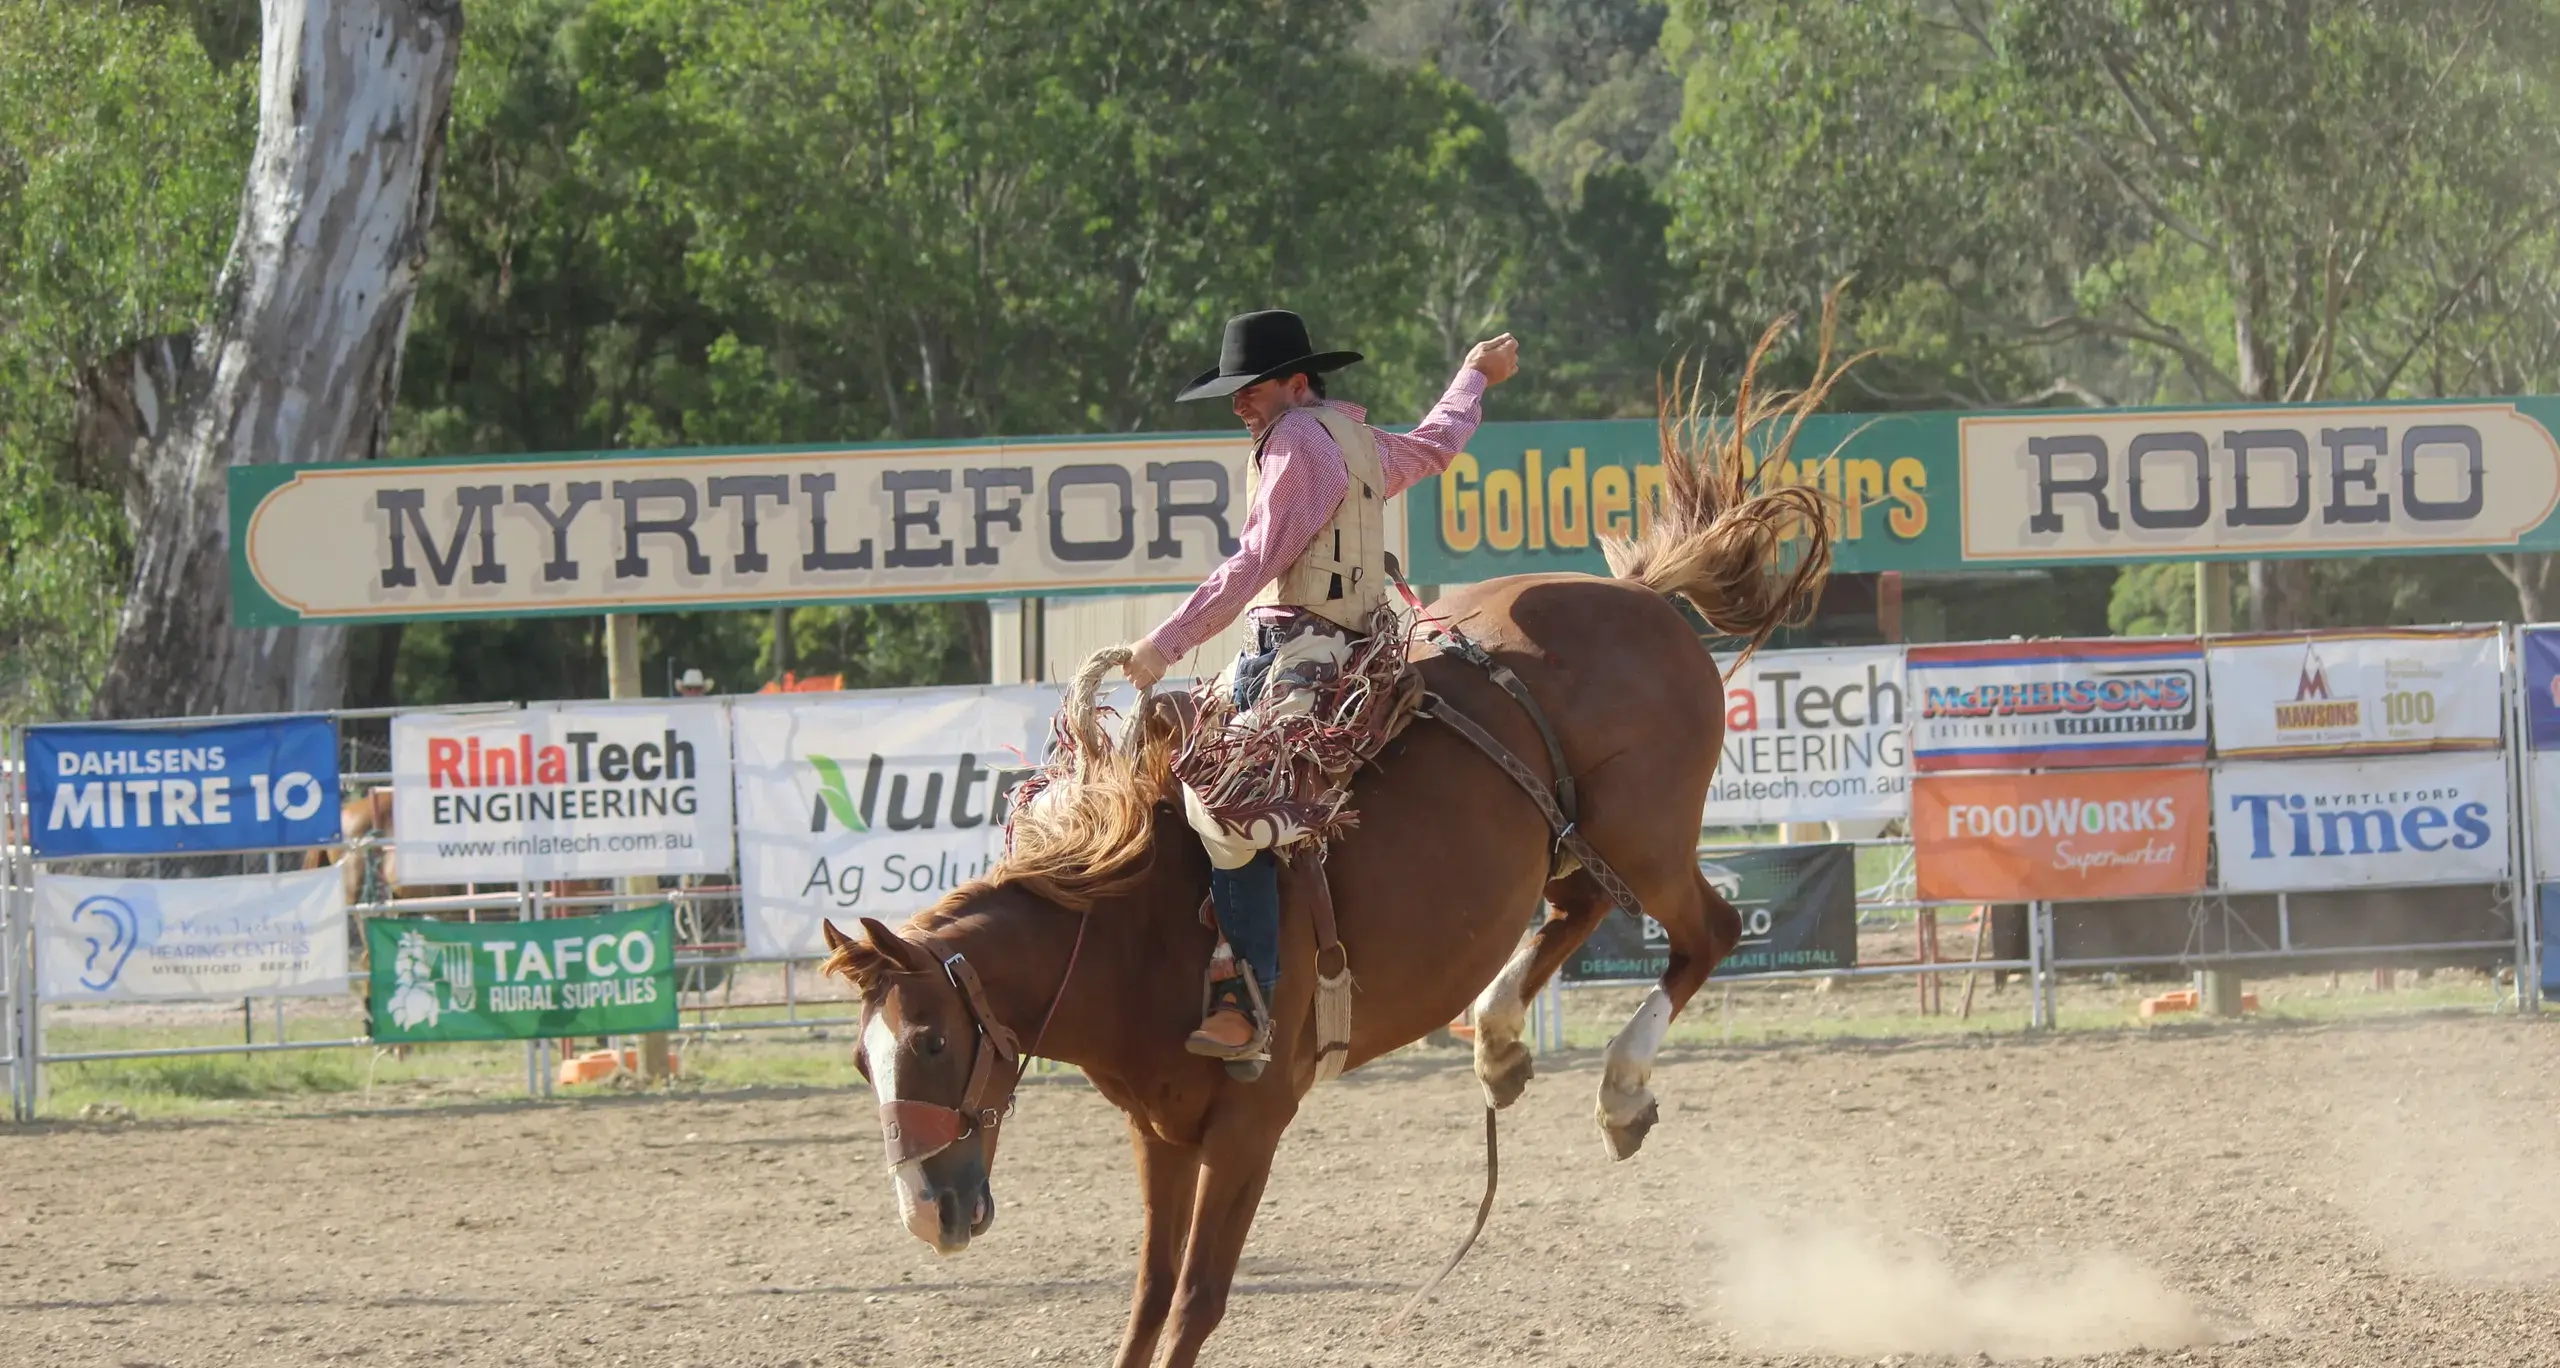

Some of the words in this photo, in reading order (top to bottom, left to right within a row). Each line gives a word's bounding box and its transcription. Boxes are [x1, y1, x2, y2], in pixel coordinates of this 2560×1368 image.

[2029, 425, 2484, 533] RODEO
[1735, 444, 1928, 562] purs
[377, 460, 1242, 588] MYRTLEFOR
[1726, 665, 1904, 732] aTech
[1925, 677, 2188, 715] McPHERSONS
[2276, 703, 2359, 729] MAWSONS
[2382, 691, 2435, 725] 100
[58, 747, 226, 776] DAHLSENS
[428, 730, 696, 788] RinlaTech
[1718, 730, 1904, 774] NEERING
[47, 777, 232, 830] MITRE
[251, 771, 323, 822] 10
[433, 786, 697, 825] ENGINEERING
[806, 748, 1055, 832] Nutr
[1708, 776, 1905, 802] nlatech.com.au
[2314, 788, 2459, 807] MYRTLEFORD
[1948, 797, 2176, 838] FOODWORKS
[2231, 794, 2491, 859] Times
[437, 834, 693, 859] www.rinlatech.com.au
[2053, 838, 2177, 879] Supermarket
[801, 856, 865, 907] Ag
[881, 851, 998, 892] Solut
[150, 943, 226, 960] HEARING
[483, 930, 655, 982] TAFCO
[1778, 950, 1839, 964] INSTALL
[489, 982, 557, 1012] RURAL
[563, 977, 657, 1009] SUPPLIES
